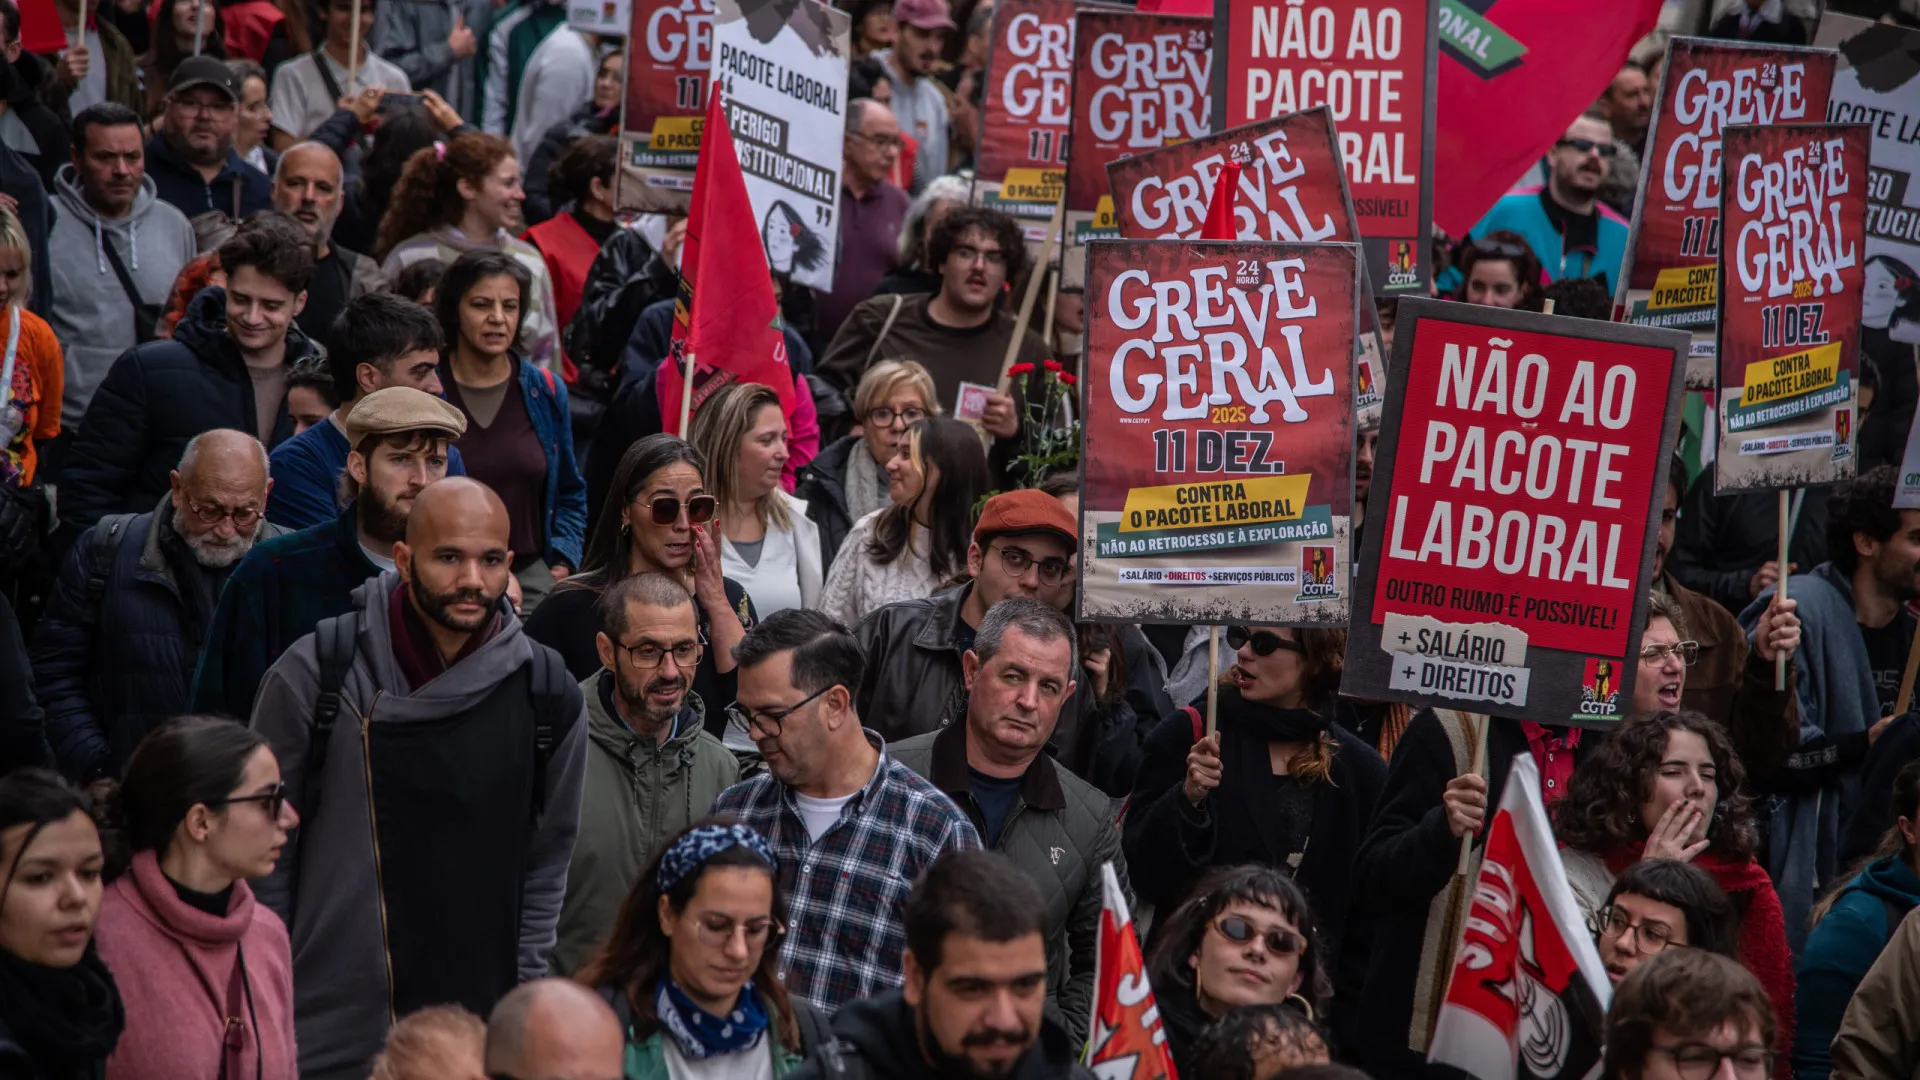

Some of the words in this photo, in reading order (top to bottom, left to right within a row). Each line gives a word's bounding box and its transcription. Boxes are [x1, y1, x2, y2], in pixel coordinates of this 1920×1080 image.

[1251, 0, 1335, 60] NÃO
[1346, 7, 1402, 61] AO
[1438, 6, 1492, 59] ONAL
[720, 42, 774, 89] PACOTE
[778, 66, 840, 116] LABORAL
[1090, 32, 1213, 97] GREV
[1761, 63, 1776, 79] 24
[676, 75, 701, 109] 11
[1246, 68, 1403, 122] PACOTE
[1675, 63, 1806, 138] GREVE
[730, 105, 781, 147] PERIGO
[1826, 99, 1895, 139] COTE
[668, 134, 702, 147] PACO
[1029, 128, 1054, 160] 11
[1229, 141, 1250, 158] 24
[1808, 141, 1821, 157] 24
[732, 137, 833, 200] NSTITUCIONAL
[1737, 138, 1849, 224] GREVE
[1353, 195, 1409, 217] SSÍVEL!
[1680, 216, 1705, 257] 11
[1737, 201, 1856, 298] GERAL
[1236, 260, 1260, 276] 24
[1236, 275, 1260, 285] HORAS
[1388, 273, 1417, 284] CGTP
[1688, 267, 1717, 286] CONT
[1108, 258, 1318, 349] GREVE
[1656, 290, 1663, 306] O
[1665, 285, 1704, 305] PACOTE
[1794, 281, 1813, 299] 2025
[1662, 309, 1710, 328] RETROCESSO
[1762, 304, 1781, 348] 11
[1784, 302, 1829, 346] DEZ.
[1109, 325, 1335, 425] GERAL
[1773, 354, 1810, 377] CONTRA
[1436, 337, 1550, 419] NÃO
[1559, 360, 1637, 430] AO
[1747, 386, 1754, 402] O
[1756, 376, 1793, 400] PACOTE
[1794, 366, 1833, 390] LABORAL
[1212, 406, 1247, 424] 2025
[1729, 413, 1744, 430] NÃO
[1745, 414, 1756, 424] AO
[1757, 403, 1799, 422] RETROCESSO
[1800, 401, 1804, 412] E
[1805, 397, 1810, 410] À
[1810, 385, 1849, 408] EXPLORAÇÃO
[1152, 428, 1187, 473] 11
[1196, 430, 1285, 475] DEZ.
[1420, 420, 1630, 509] PACOTE
[1176, 483, 1247, 505] CONTRA
[1130, 510, 1142, 528] O
[1146, 505, 1212, 528] PACOTE
[1216, 498, 1296, 522] LABORAL
[1101, 540, 1127, 555] NÃO
[1129, 540, 1146, 552] AO
[1148, 532, 1226, 551] RETROCESSO
[1228, 531, 1235, 544] E
[1238, 527, 1247, 543] À
[1249, 520, 1328, 541] EXPLORAÇÃO
[1388, 495, 1630, 589] LABORAL
[1121, 567, 1162, 581] +SALÁRIO
[1164, 571, 1207, 581] +DIREITOS
[1208, 572, 1253, 583] +SERVIÇOS
[1254, 569, 1295, 582] PÚBLICOS
[1303, 584, 1333, 595] CGTP
[1386, 578, 1446, 608] OUTRO
[1450, 587, 1505, 615] RUMO
[1507, 592, 1521, 617] É
[1524, 597, 1618, 630] POSSÍVEL!
[1416, 628, 1506, 663] SALÁRIO
[1420, 662, 1516, 699] DIREITOS
[1580, 700, 1617, 715] CGTP
